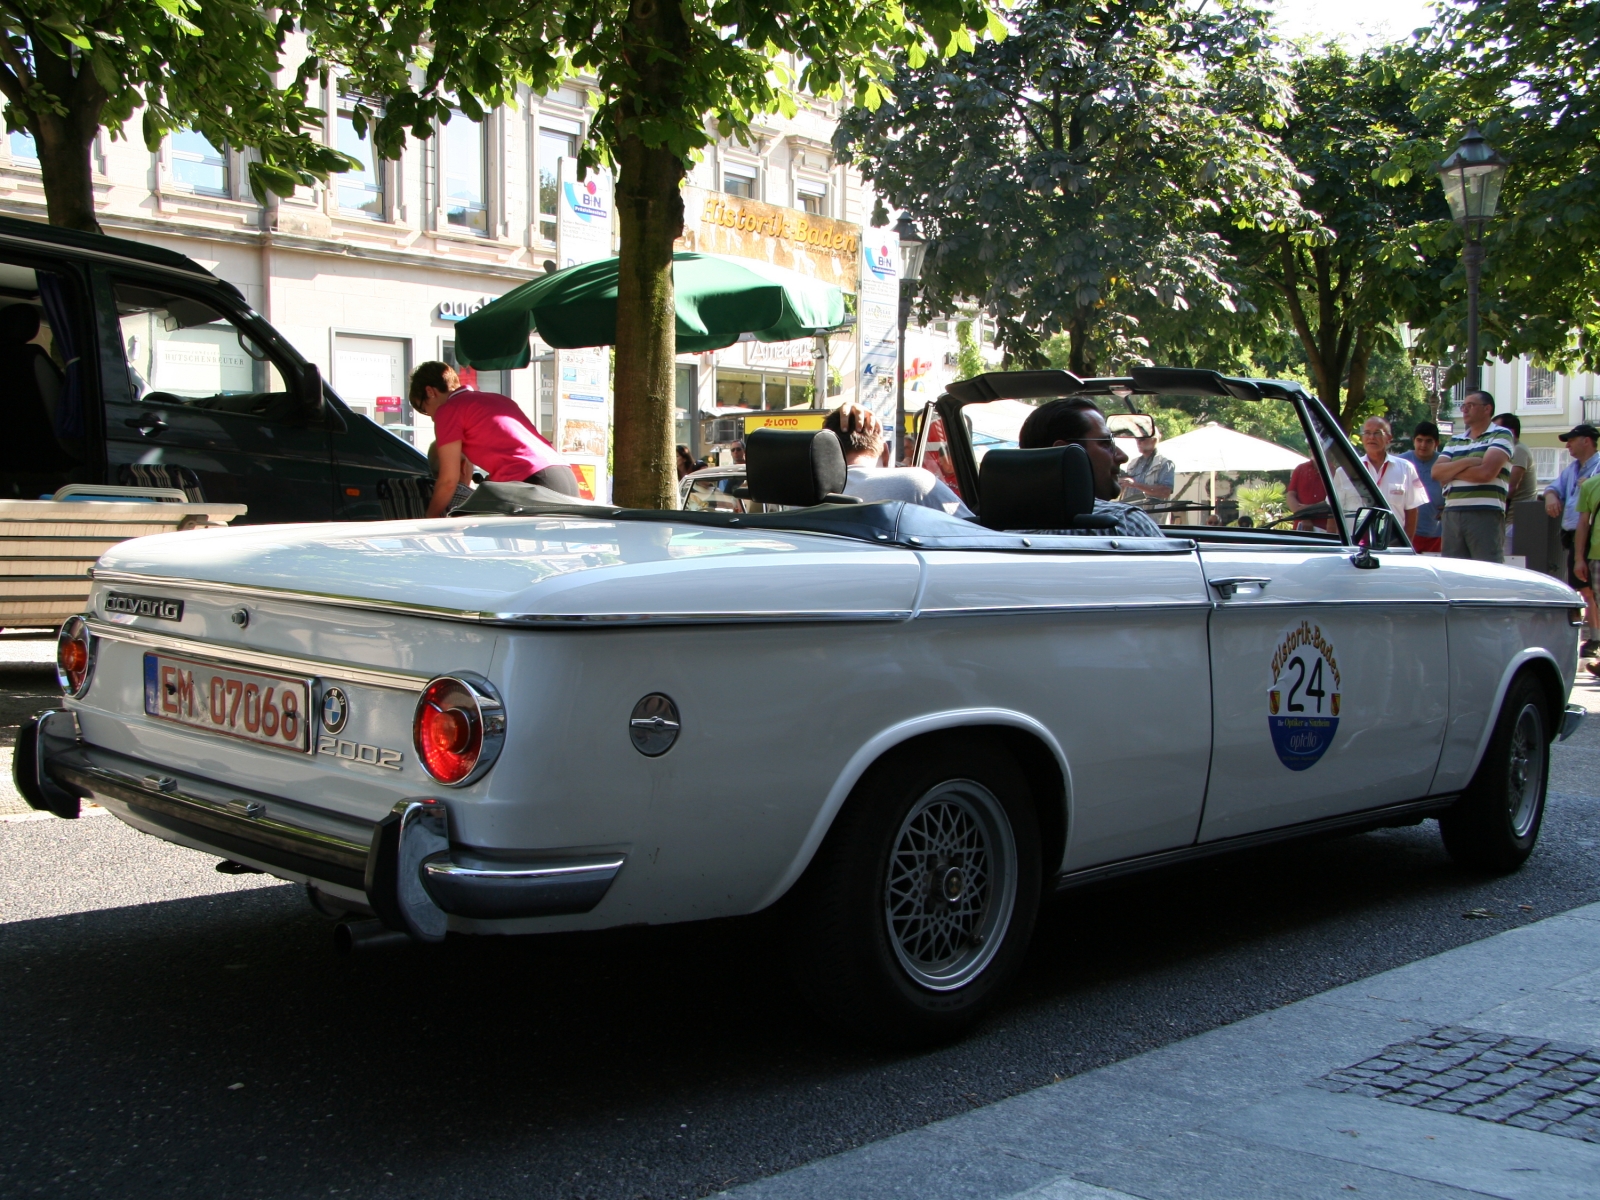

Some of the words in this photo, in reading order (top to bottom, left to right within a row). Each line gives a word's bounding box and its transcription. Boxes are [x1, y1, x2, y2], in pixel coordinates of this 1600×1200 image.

[701, 198, 857, 253] Historik-Baden
[165, 353, 244, 365] HUTSCHENREUTER
[774, 419, 798, 427] LOTTO
[1271, 620, 1341, 690] Historik-Baden
[162, 665, 194, 717] EM
[210, 676, 298, 741] 07068
[324, 689, 345, 706] BMW
[1287, 656, 1325, 714] 24
[1284, 718, 1304, 729] Optiker
[318, 735, 404, 771] 2002
